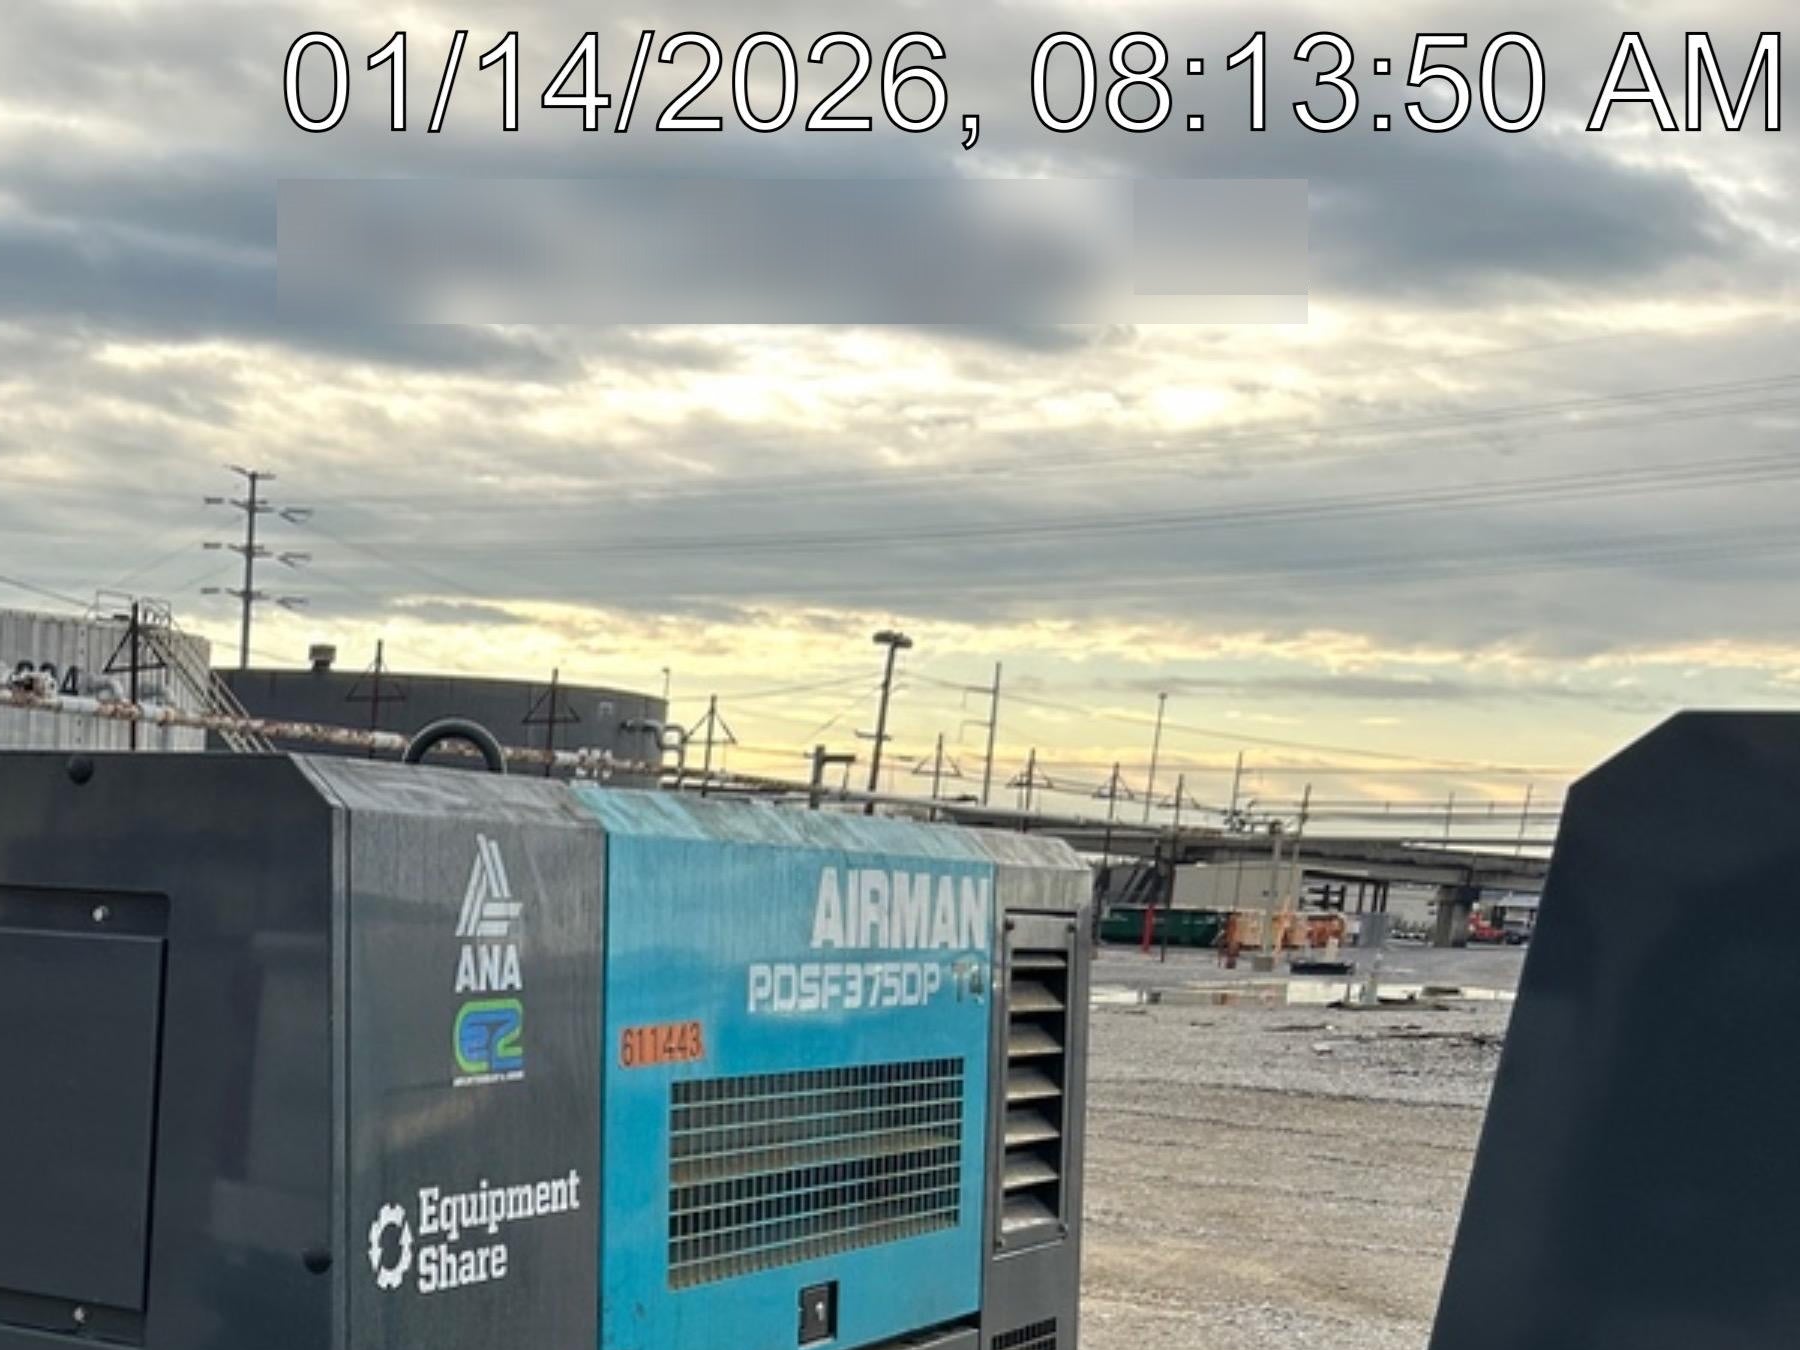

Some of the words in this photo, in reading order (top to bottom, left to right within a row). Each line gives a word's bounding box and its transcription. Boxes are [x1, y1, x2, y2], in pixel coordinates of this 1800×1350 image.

[810, 866, 990, 950] AIRMAN
[455, 944, 522, 993] ANA
[418, 1169, 580, 1241] Equipment
[418, 1243, 508, 1294] Share
